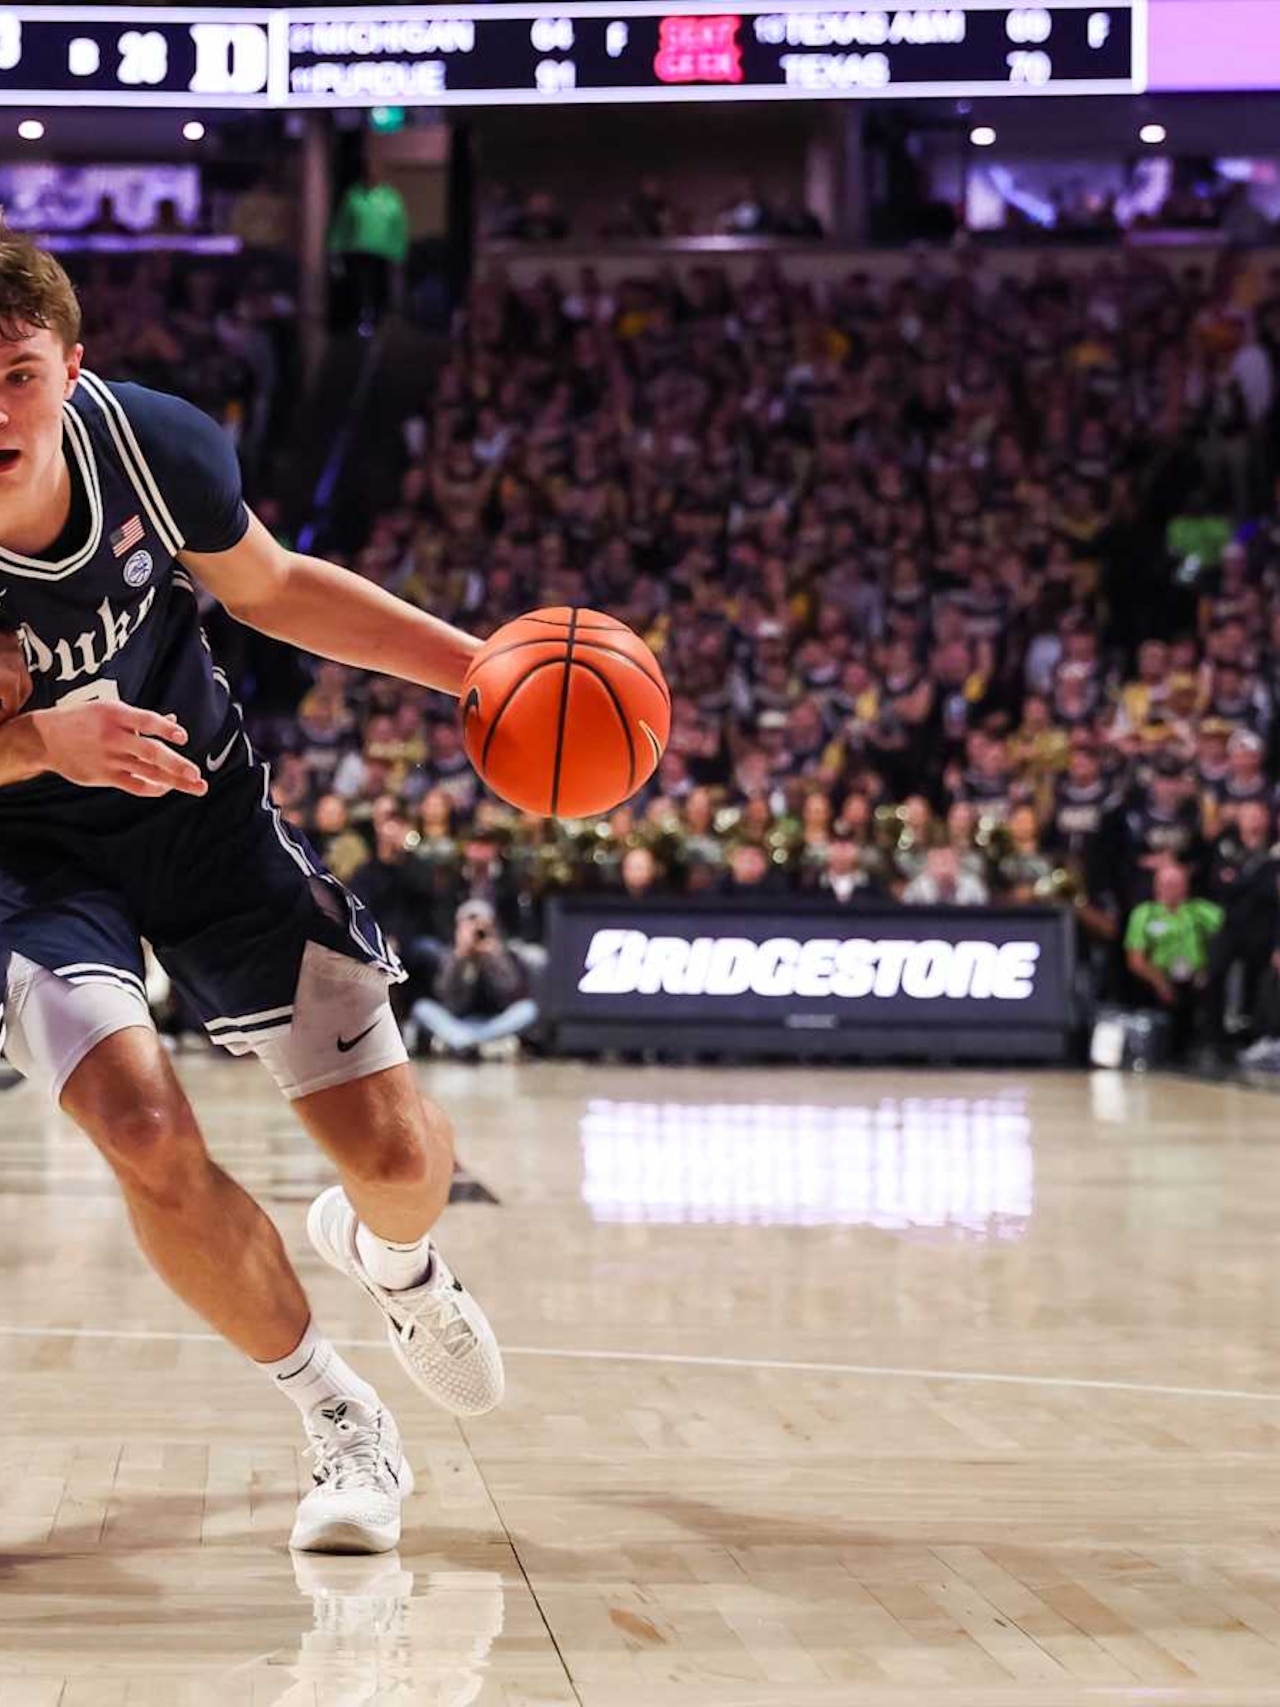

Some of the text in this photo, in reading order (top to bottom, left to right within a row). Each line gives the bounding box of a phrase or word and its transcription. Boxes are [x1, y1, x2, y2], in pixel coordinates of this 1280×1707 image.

[313, 19, 475, 54] MICHIGAN
[786, 11, 889, 45] TEXAS
[190, 24, 267, 92] D
[781, 52, 889, 88] TEXAS
[313, 60, 446, 95] PURDUE
[578, 929, 1040, 999] BRIDGESTONE
